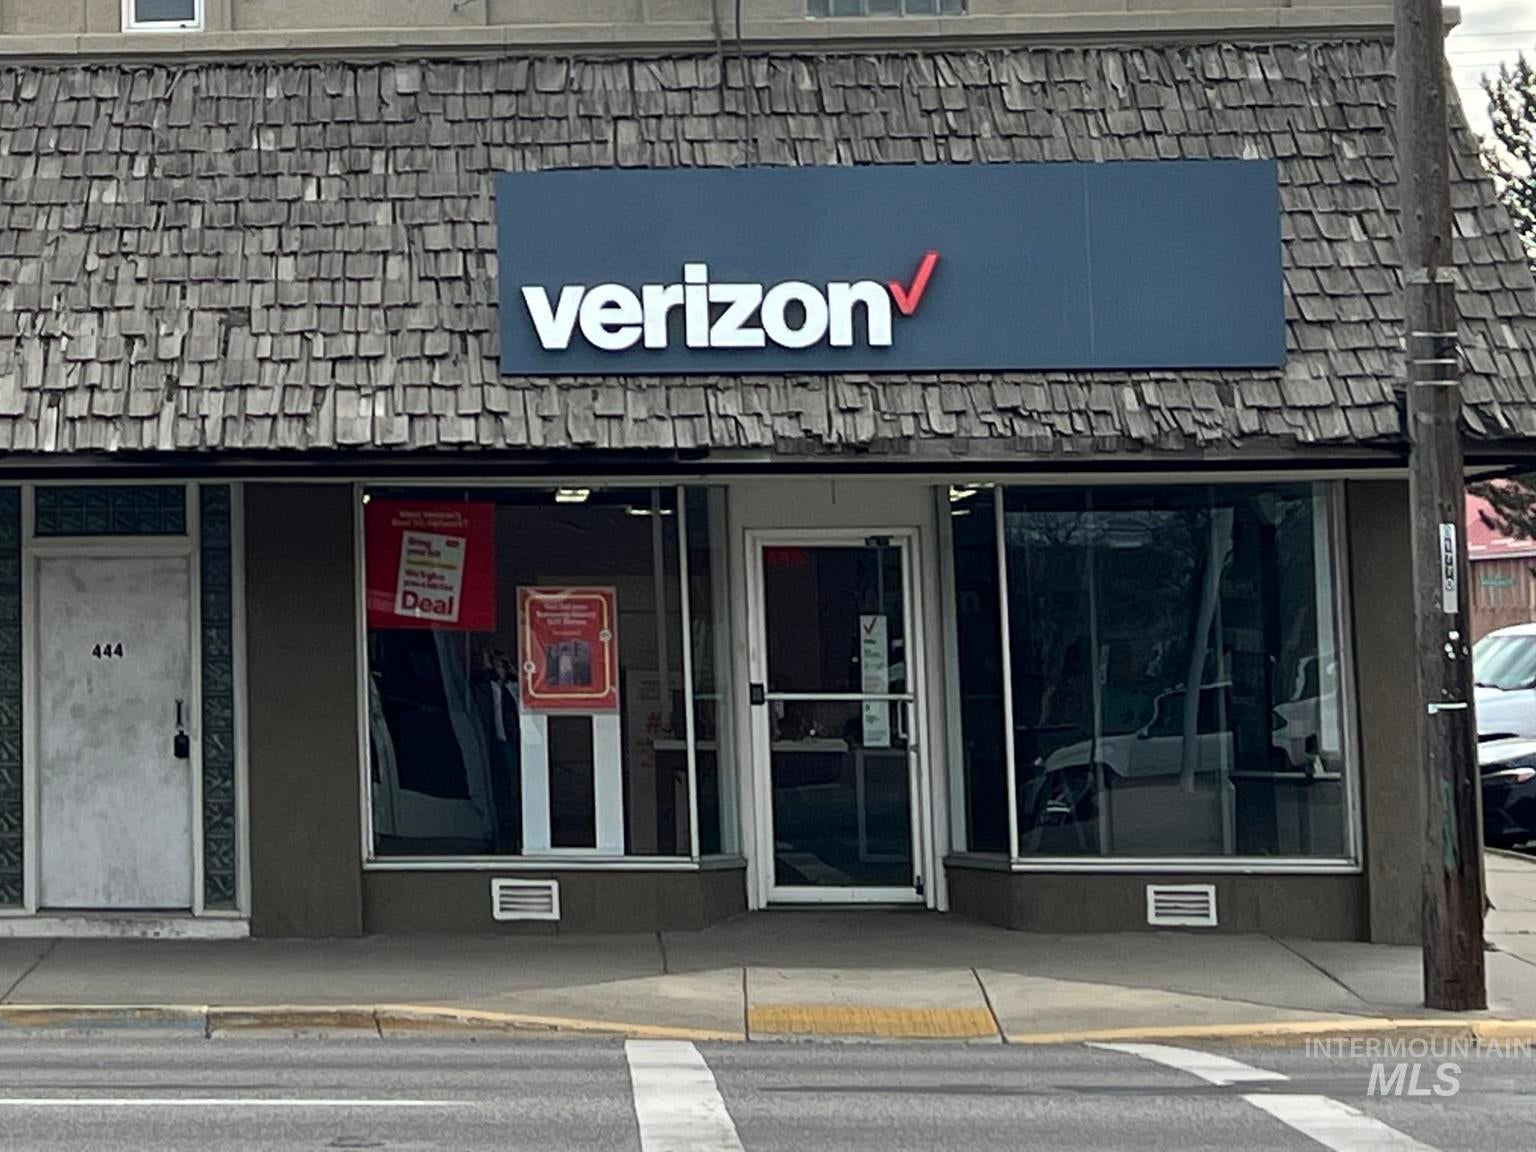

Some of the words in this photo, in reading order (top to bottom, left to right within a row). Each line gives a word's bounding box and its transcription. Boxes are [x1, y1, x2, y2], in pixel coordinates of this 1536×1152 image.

[520, 262, 893, 352] verizon
[401, 589, 454, 616] Deal
[92, 642, 123, 659] 444
